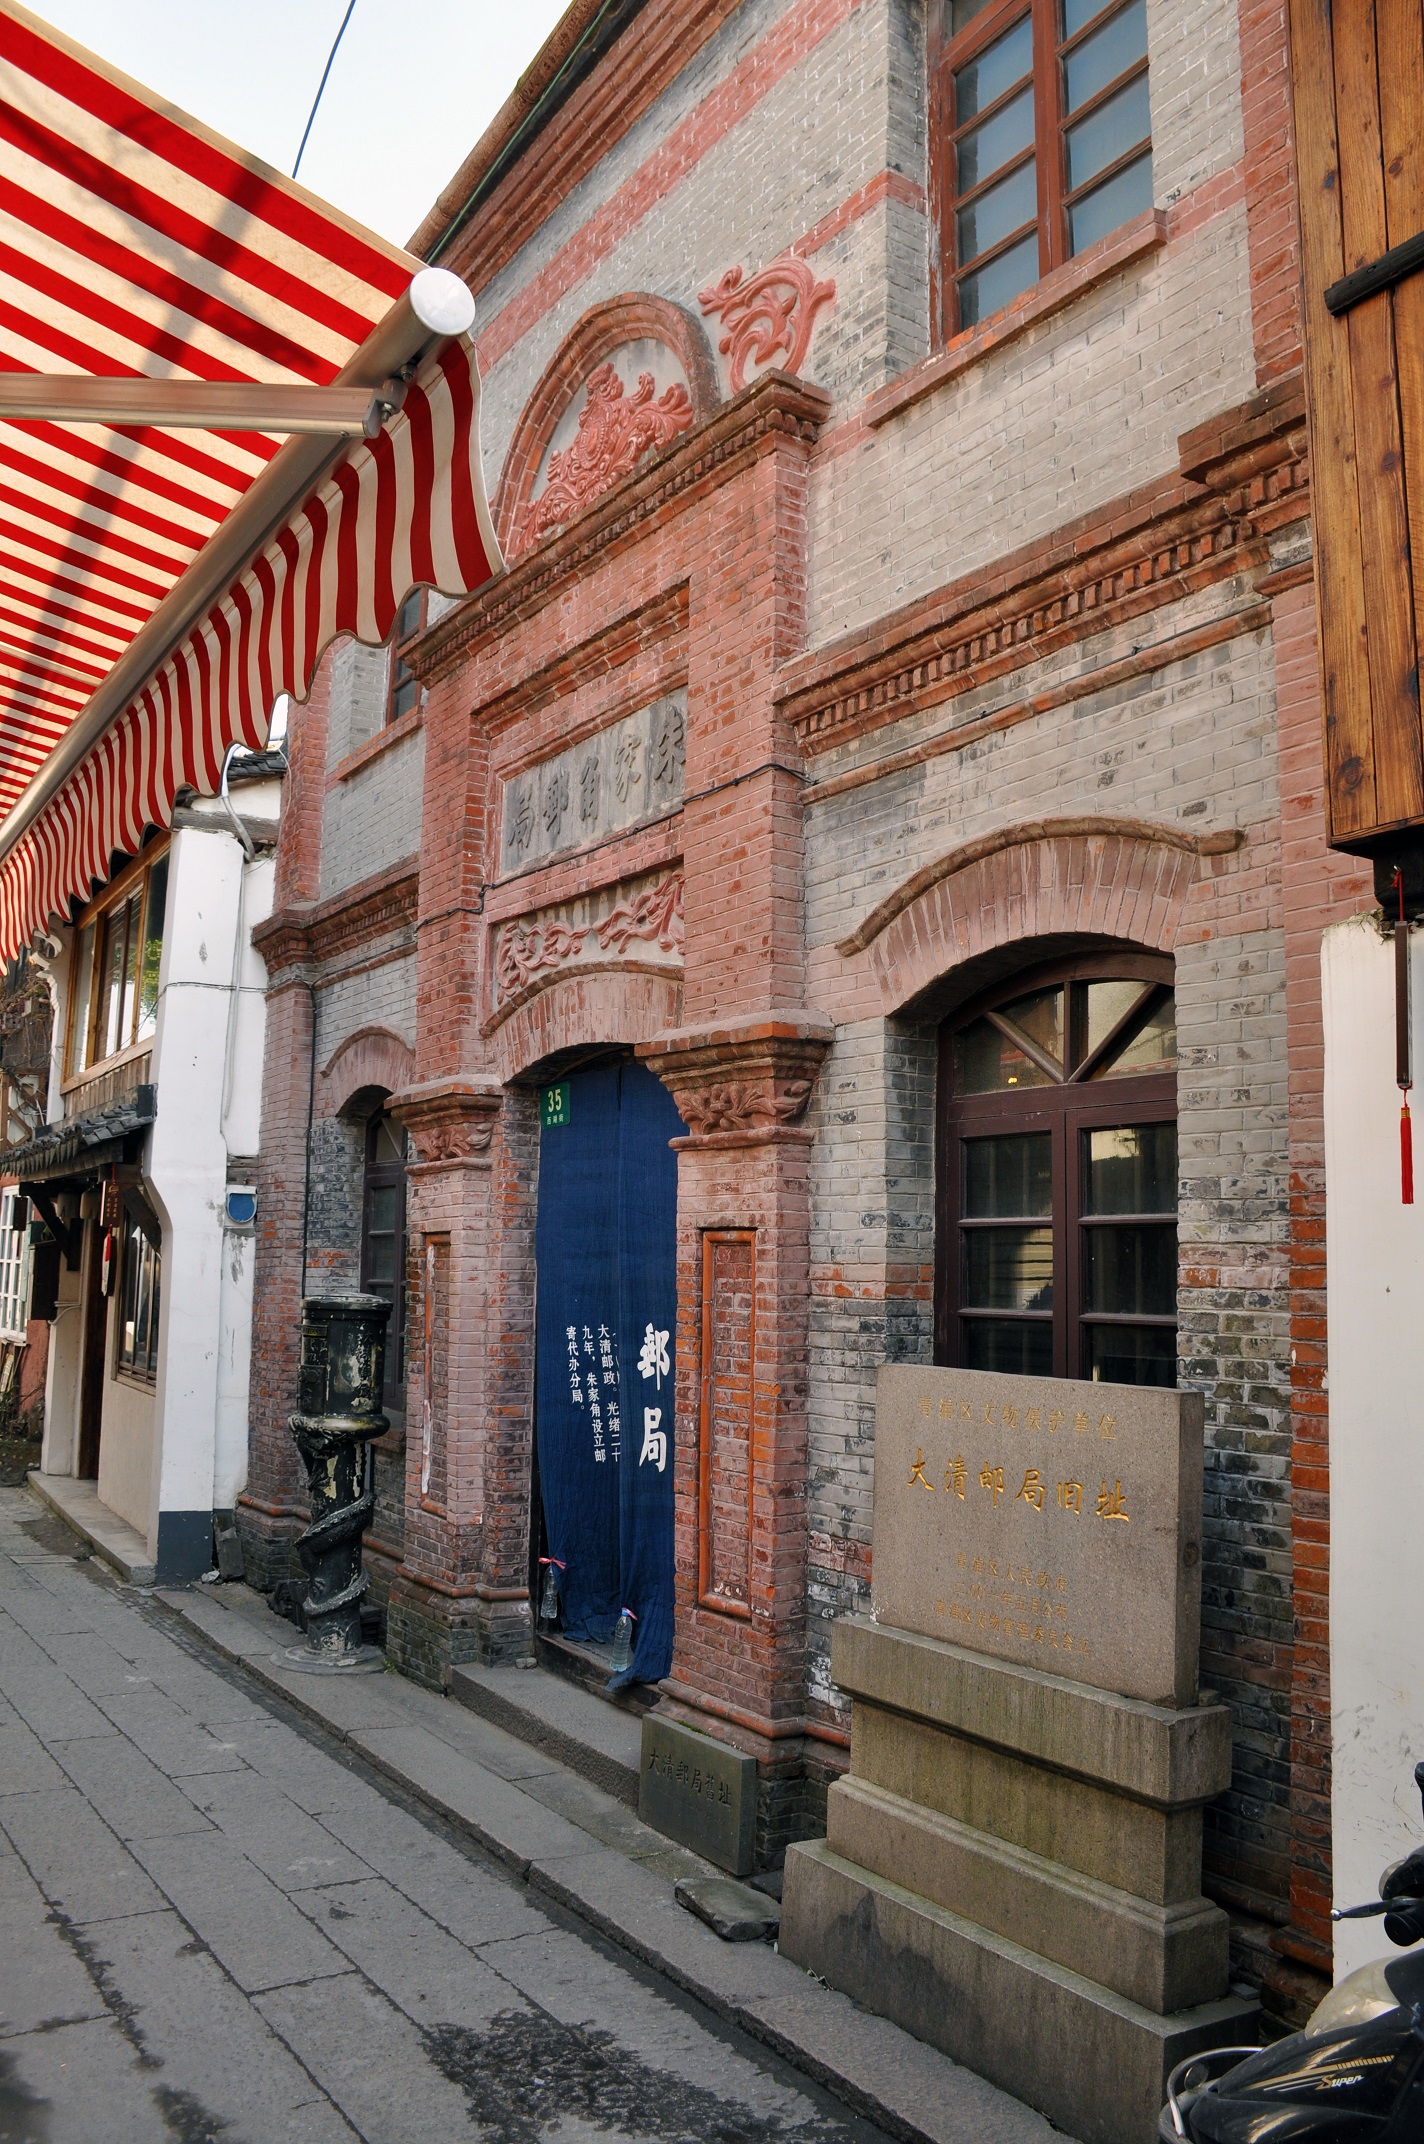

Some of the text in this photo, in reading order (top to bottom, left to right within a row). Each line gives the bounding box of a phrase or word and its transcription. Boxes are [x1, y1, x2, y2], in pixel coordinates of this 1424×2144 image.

[547, 1088, 562, 1112] 35
[637, 1322, 670, 1473] 郵局
[918, 1396, 1117, 1440] 青浦区文物保护单位
[907, 1448, 1130, 1522] 大清邮局旧址
